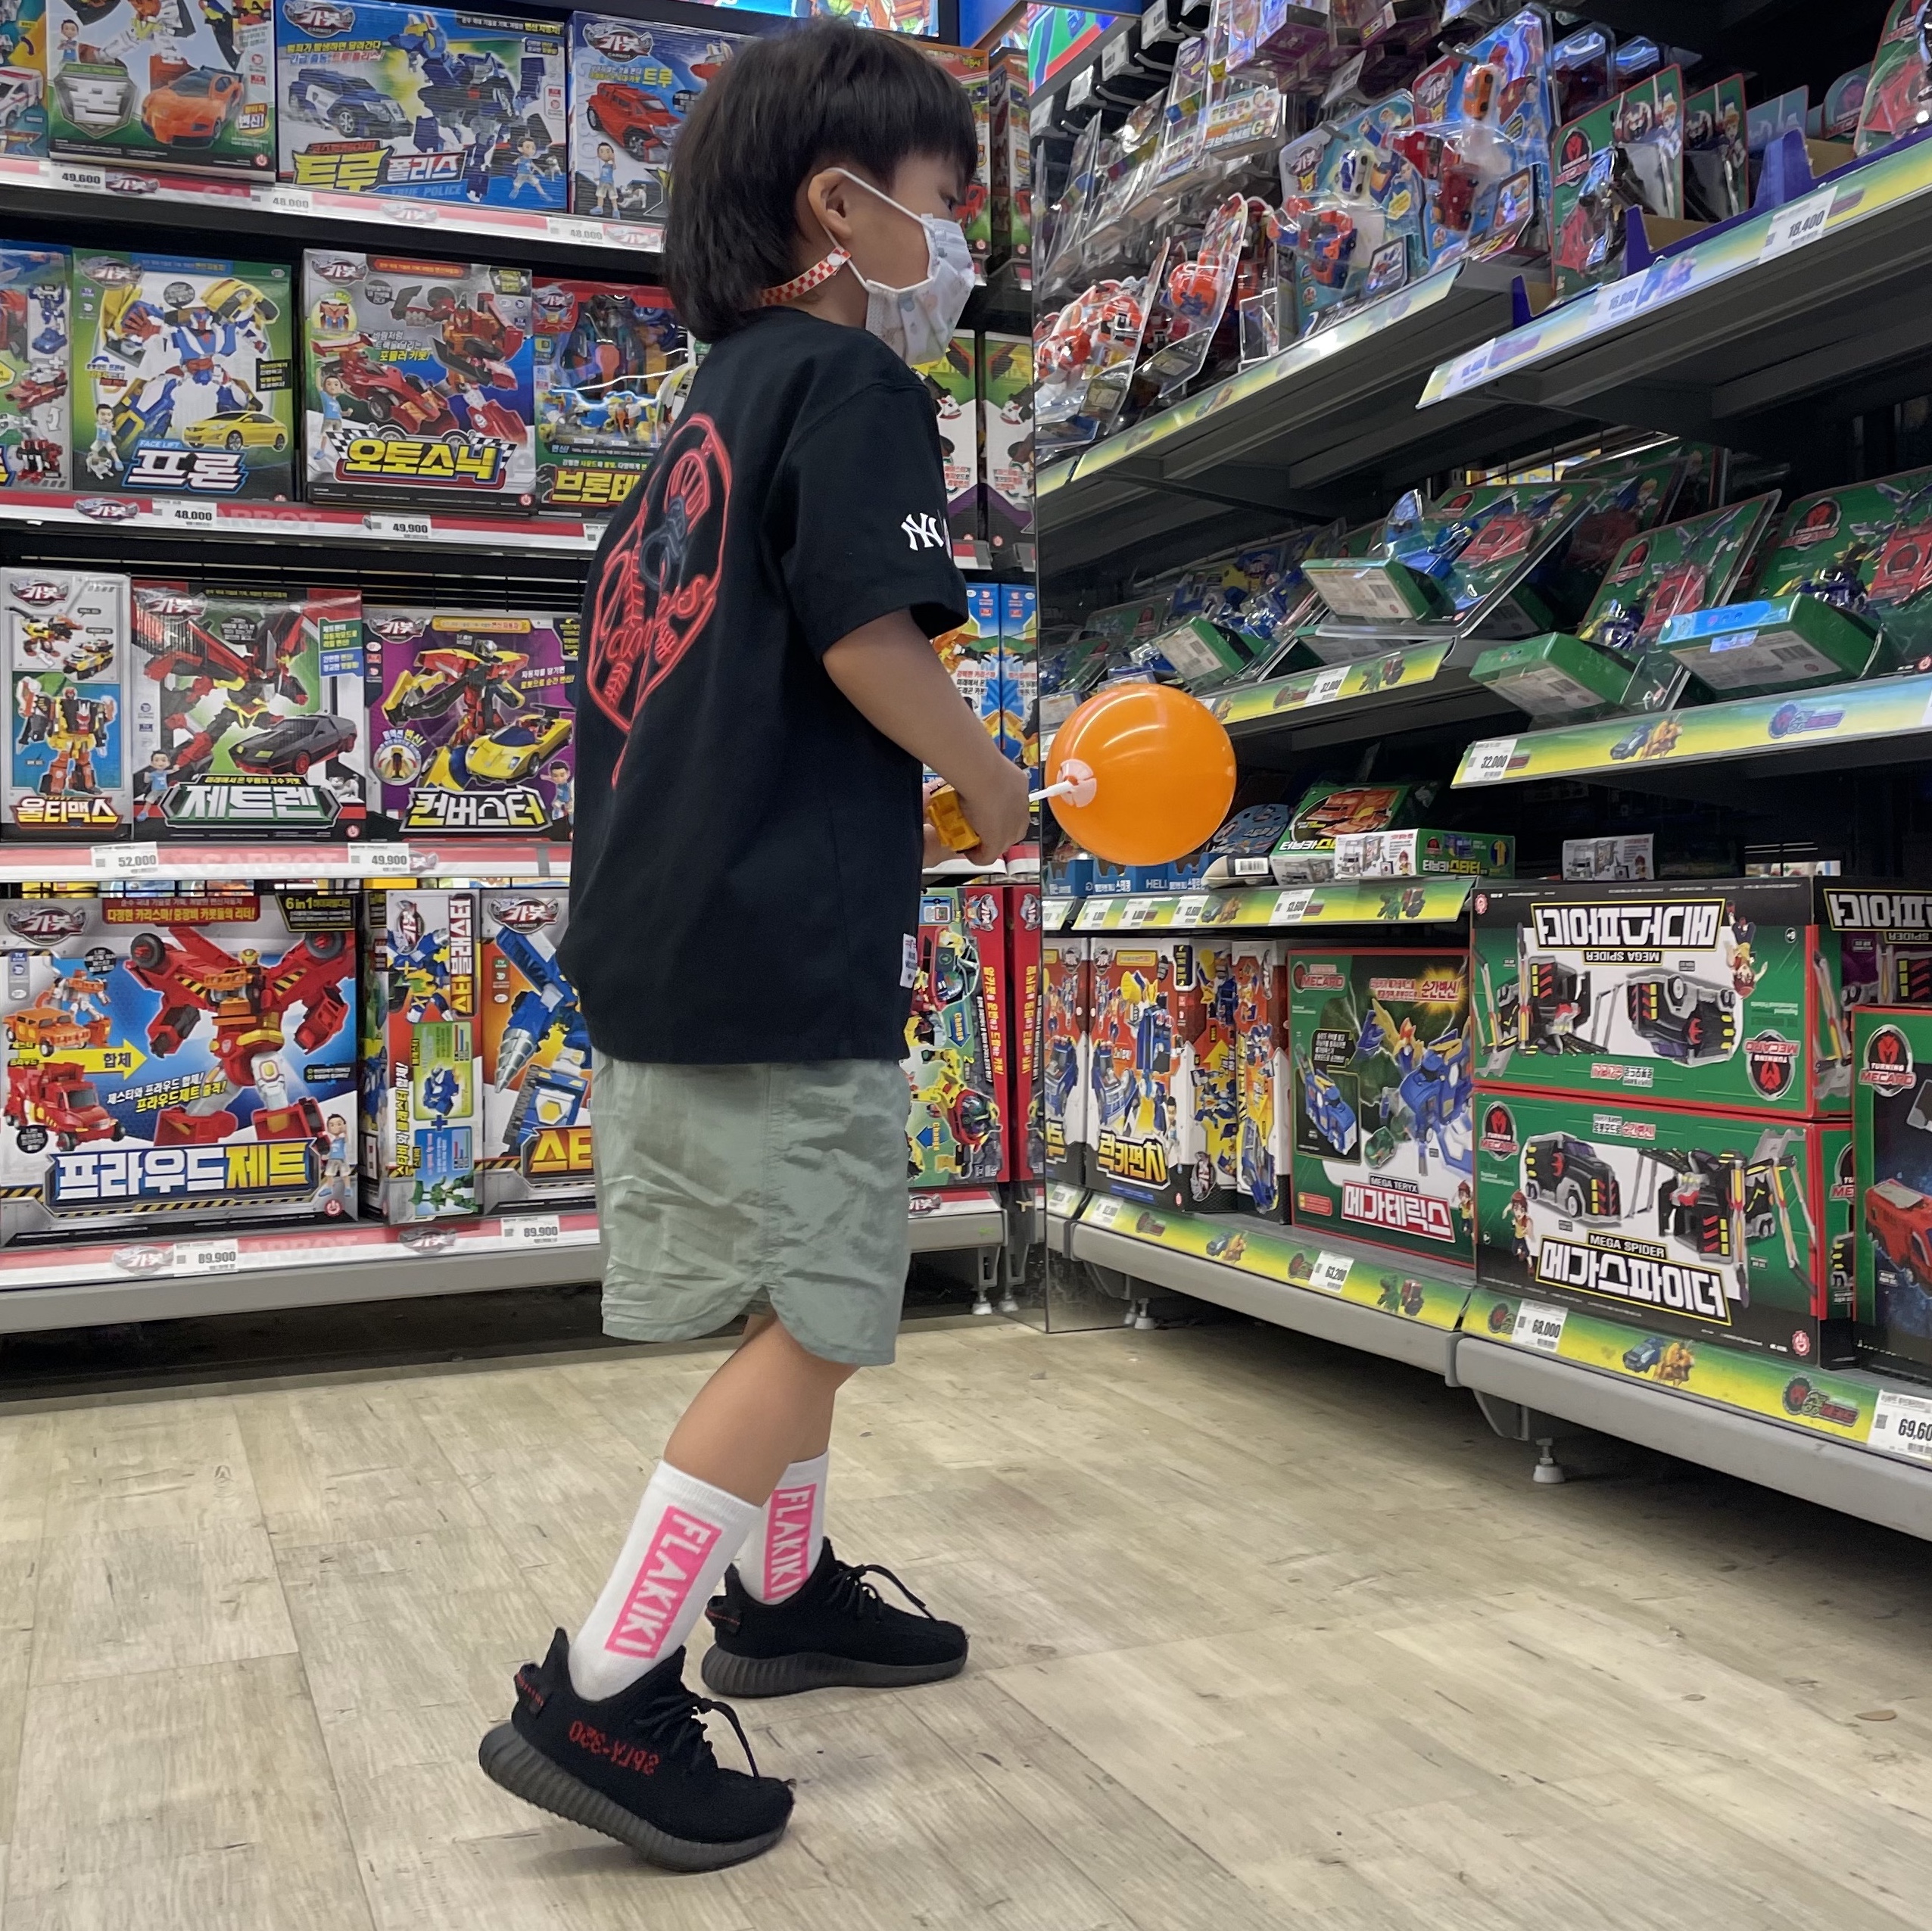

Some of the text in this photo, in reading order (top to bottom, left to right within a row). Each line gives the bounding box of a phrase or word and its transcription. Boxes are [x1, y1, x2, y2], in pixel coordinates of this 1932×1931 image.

[295, 9, 340, 26] 카봇
[599, 34, 640, 50] 카봇
[61, 173, 101, 185] 49,600
[295, 151, 459, 192] 트루 폴리스
[423, 184, 462, 197] POLICE
[139, 439, 182, 449] FACE LIFT
[347, 438, 497, 481] 오토소닉
[174, 509, 213, 521] 48,000
[393, 523, 428, 533] 49,900
[900, 512, 945, 551] NY
[20, 585, 58, 600] 카봇
[150, 597, 195, 614] 카봇
[381, 621, 417, 634] 카봇
[1481, 755, 1508, 768] 32,000
[17, 797, 119, 824] 울티맥스
[175, 786, 326, 820] 제트렌
[408, 792, 547, 827] 컨버스터
[118, 855, 157, 867] 52,000
[372, 855, 407, 865] 49,900
[1145, 879, 1170, 889] HELL
[503, 904, 550, 921] 카봇
[1828, 892, 1932, 929] 파이더
[25, 914, 73, 931] 카봇
[1535, 905, 1722, 947] 메가스파이더
[1586, 951, 1660, 962] MEGA SPIDER
[1301, 975, 1344, 987] MECARD
[104, 1051, 132, 1068] 합체
[1859, 1071, 1914, 1085] MECARD
[57, 1143, 310, 1201] 프라우드제트
[1370, 1176, 1419, 1193] MEGA TERYX
[1345, 1185, 1453, 1237] 메가테릭스
[524, 1226, 559, 1237] 89,900
[1591, 1235, 1665, 1258] MEGA SPIDER
[198, 1251, 236, 1264] 89,900
[1539, 1241, 1727, 1317] 메가스파이더
[1898, 1418, 1932, 1442] 69,60
[771, 1489, 811, 1594] FLAKIKI
[614, 1514, 712, 1652] FLAKIKI
